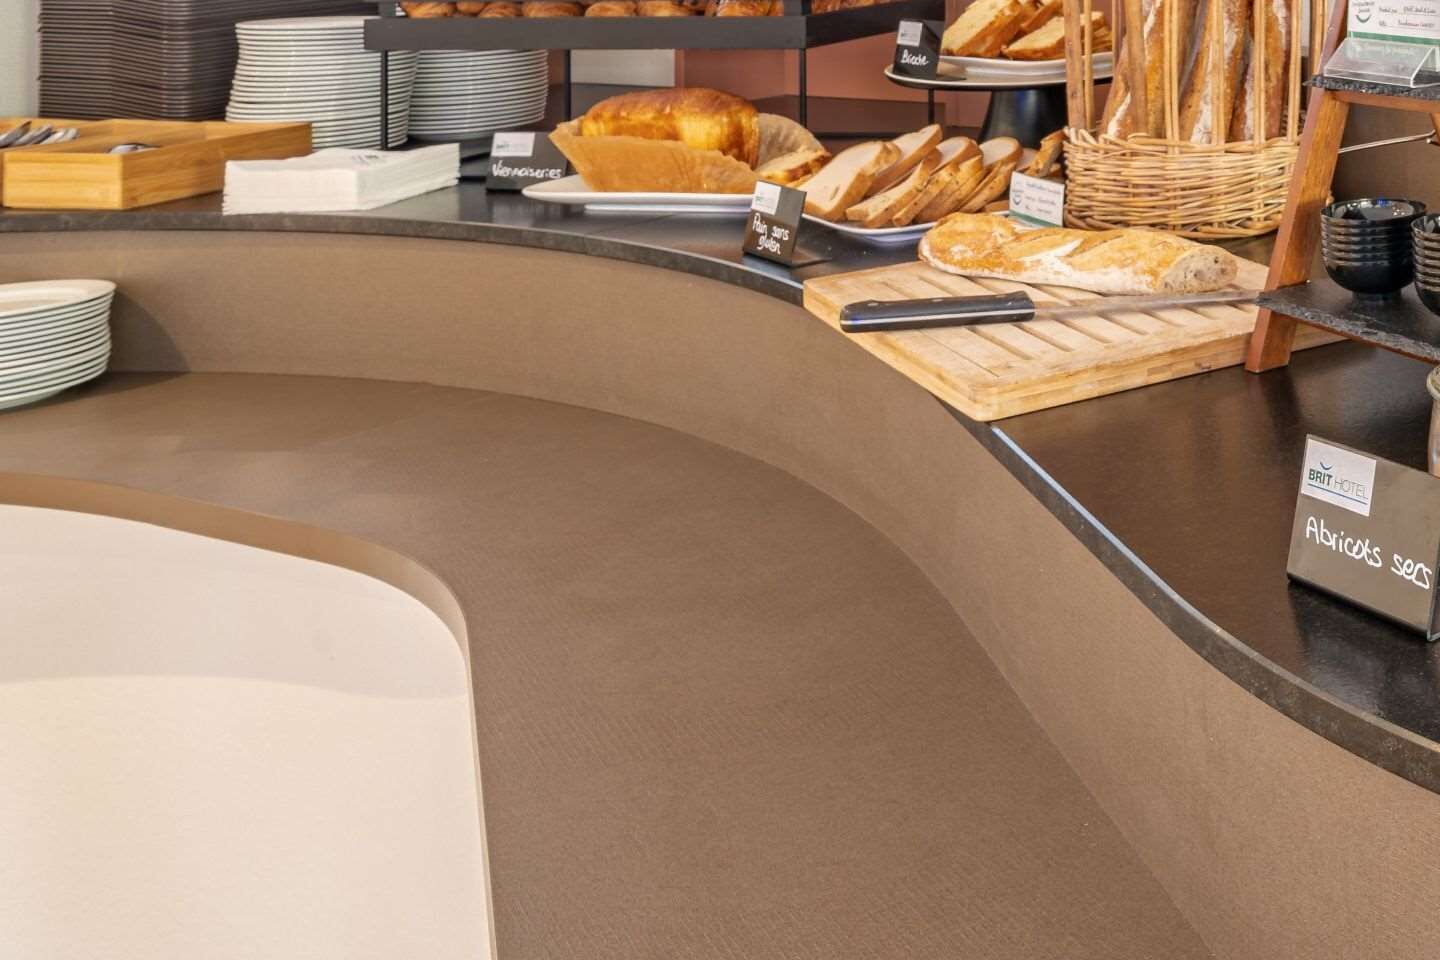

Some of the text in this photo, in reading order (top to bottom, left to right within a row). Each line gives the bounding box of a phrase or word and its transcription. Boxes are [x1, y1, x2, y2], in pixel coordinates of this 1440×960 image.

[1308, 468, 1369, 499] BRIT HOTEL
[1306, 516, 1433, 590] Abricots secs
